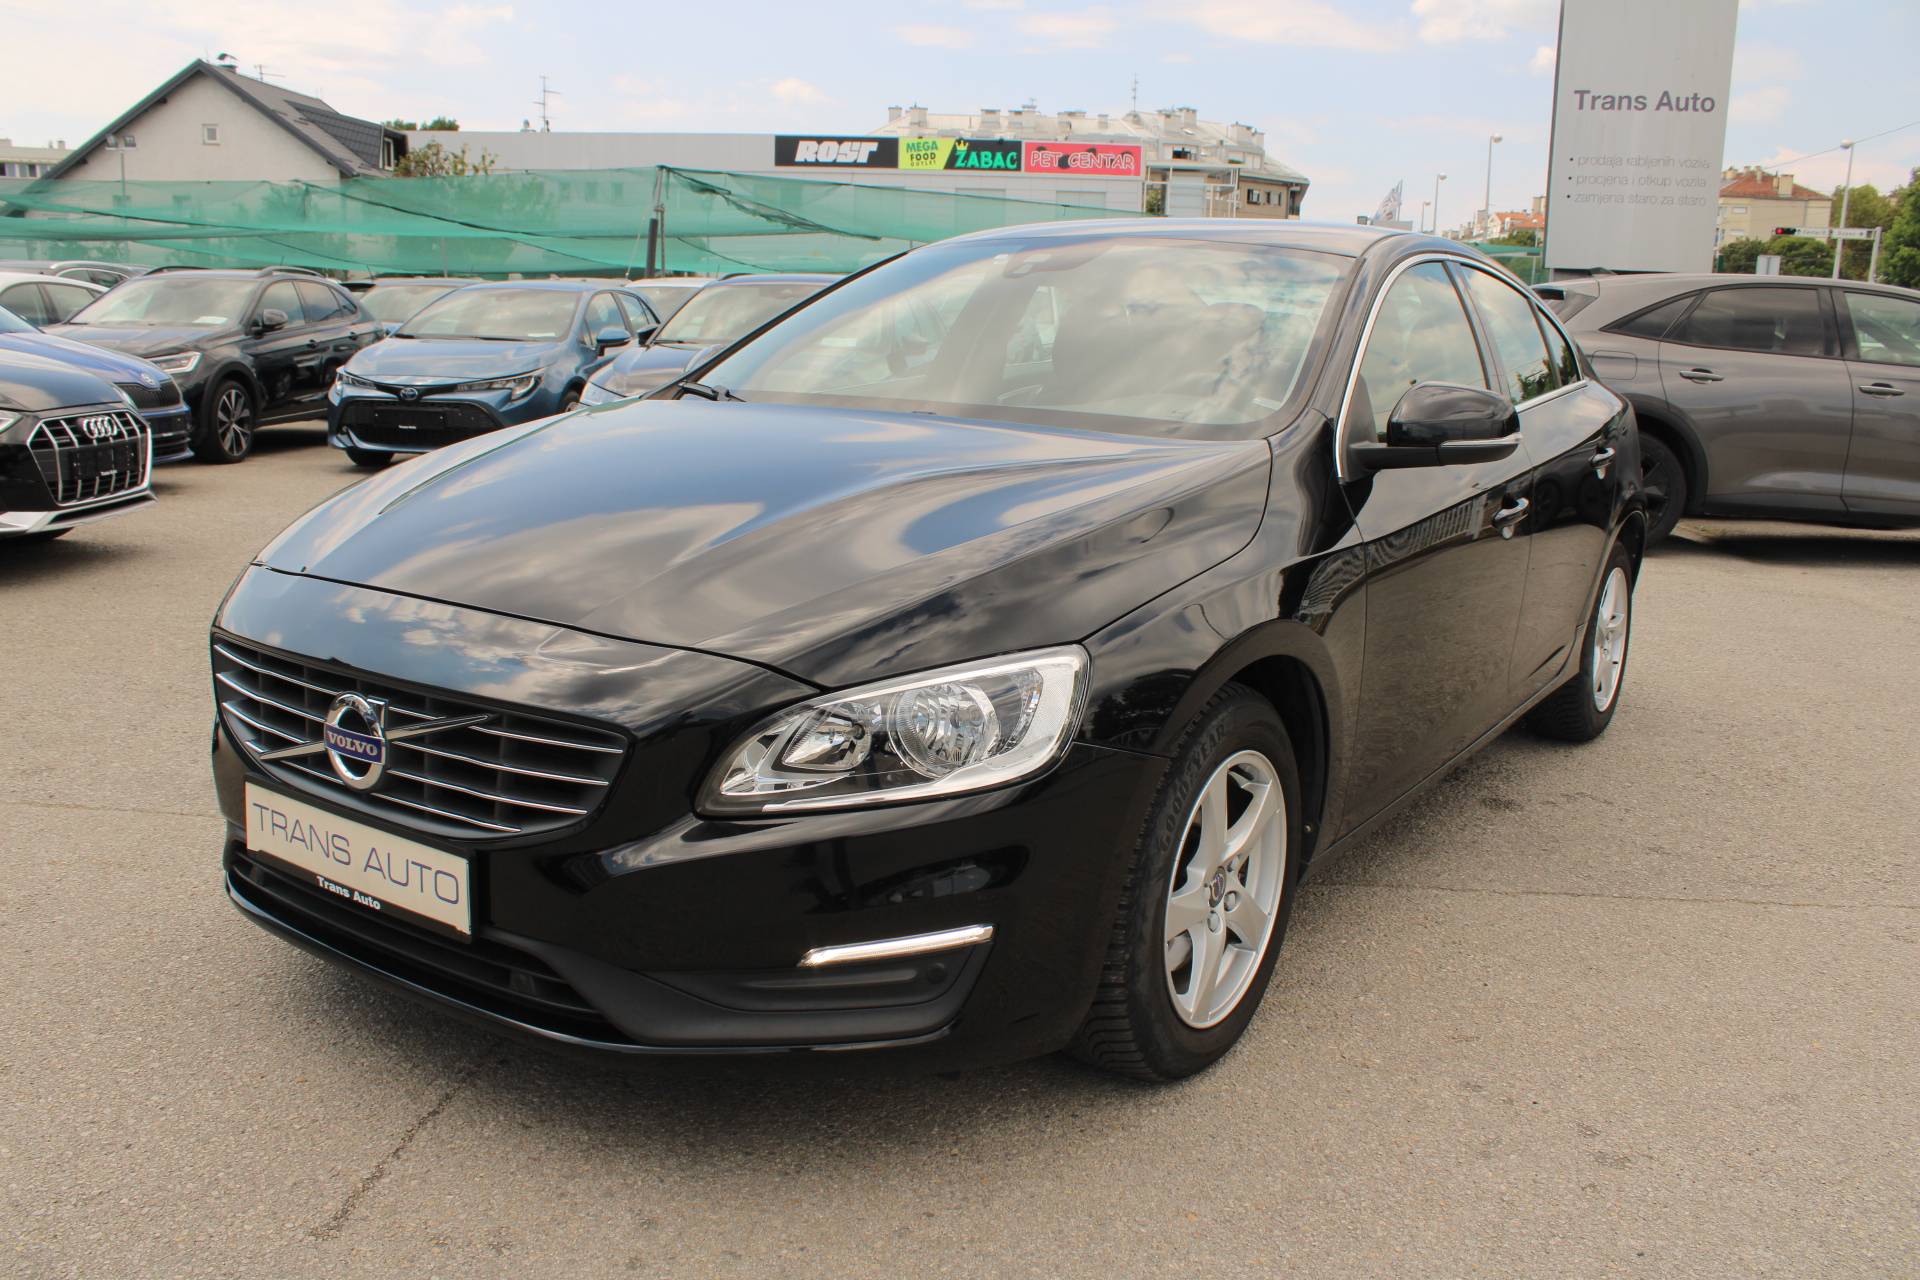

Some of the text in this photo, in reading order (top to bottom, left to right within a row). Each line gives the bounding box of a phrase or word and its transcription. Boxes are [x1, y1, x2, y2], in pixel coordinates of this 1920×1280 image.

[1574, 90, 1715, 113] Trans Auto
[794, 140, 879, 164] ROST
[906, 141, 938, 152] MEGA
[910, 152, 936, 161] FOOD
[1030, 151, 1135, 170] PET CENTAR
[1638, 174, 1672, 187] otkup
[327, 731, 378, 756] VOLVO
[252, 802, 459, 905] TRANS AUTO
[316, 875, 381, 910] Trans Auto
